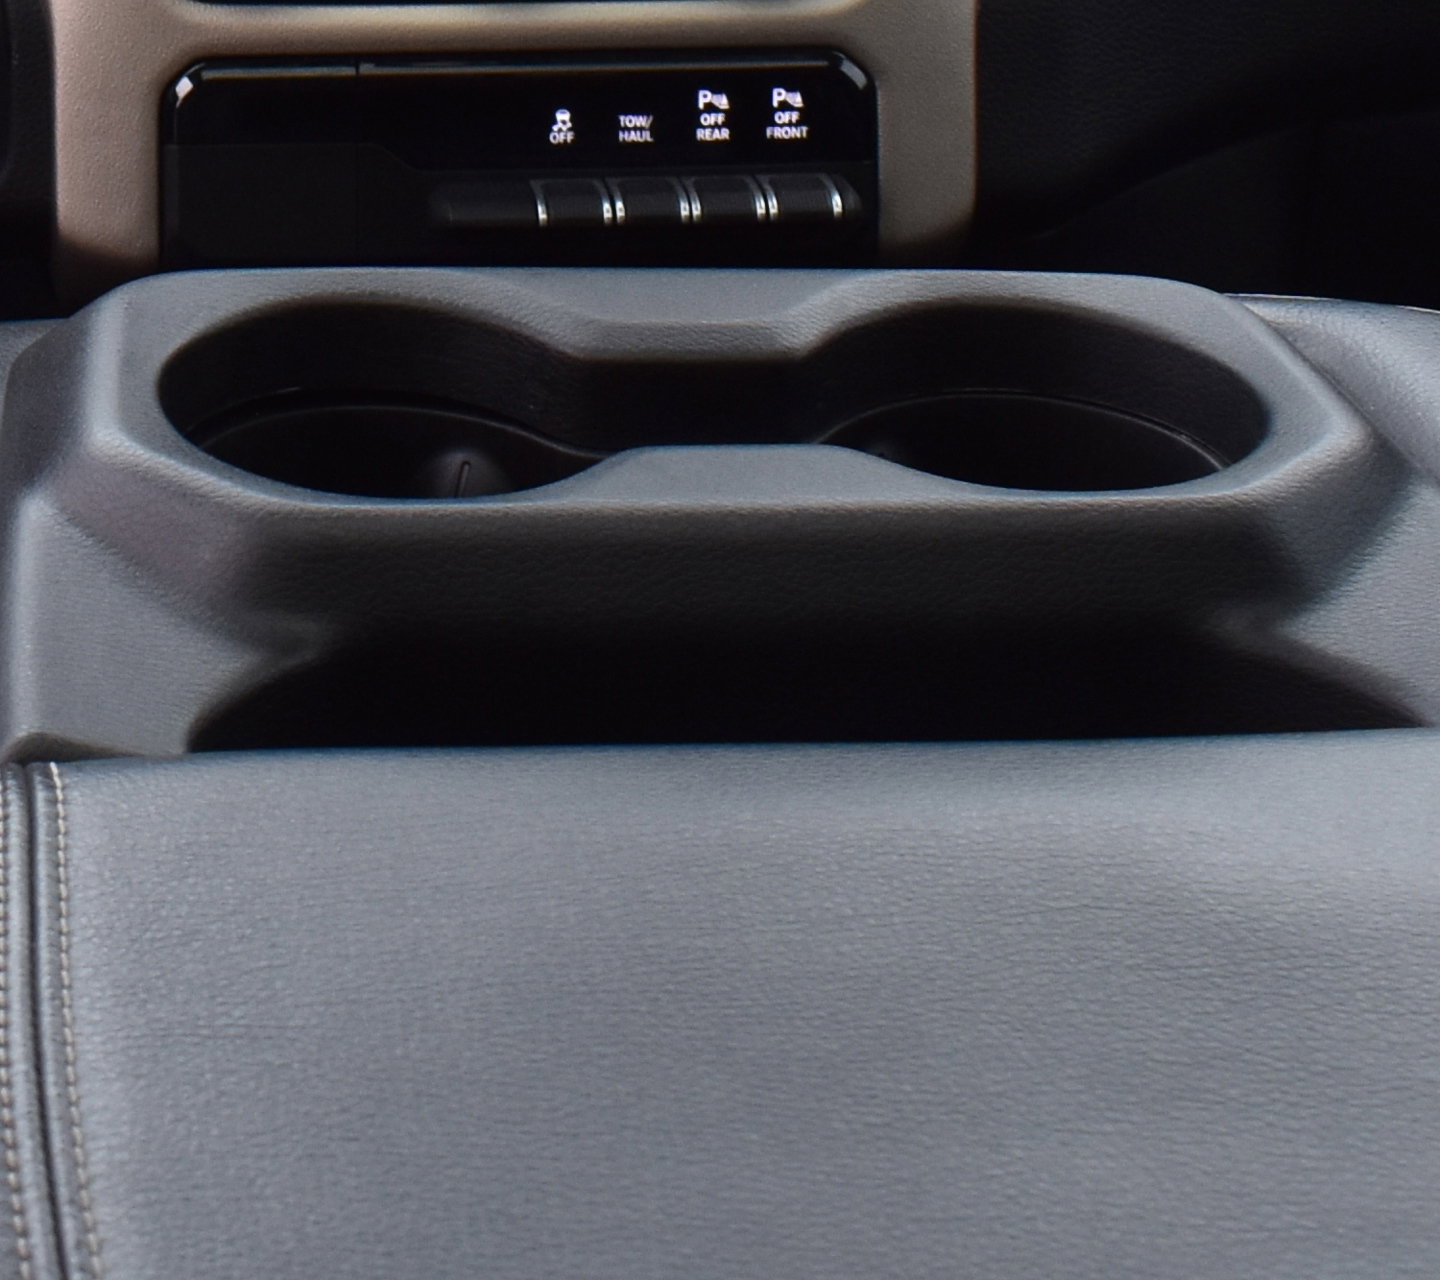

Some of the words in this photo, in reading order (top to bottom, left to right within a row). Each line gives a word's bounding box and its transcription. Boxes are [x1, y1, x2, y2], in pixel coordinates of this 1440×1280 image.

[619, 114, 654, 129] TOW/
[700, 113, 725, 126] OFF
[774, 111, 800, 124] OFF
[549, 132, 574, 145] OFF
[619, 129, 654, 142] HAUL
[696, 127, 730, 140] REAR
[766, 126, 808, 139] FRONT
